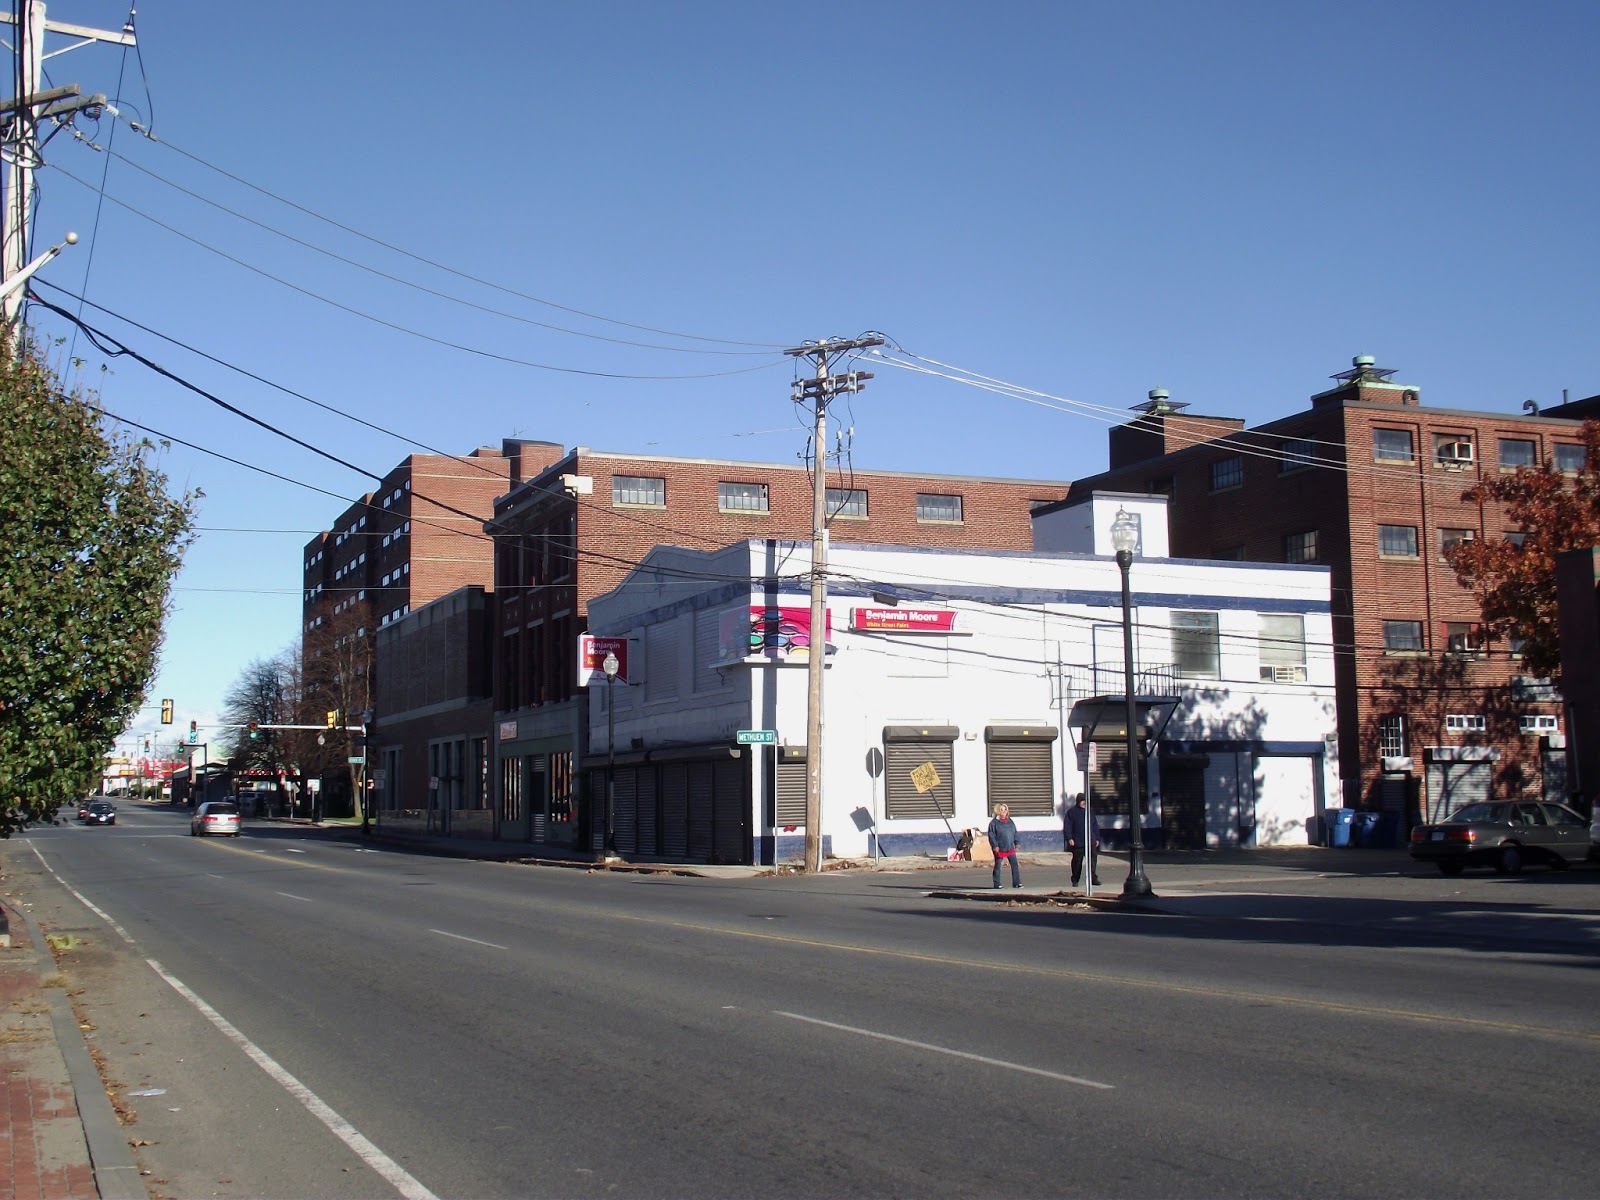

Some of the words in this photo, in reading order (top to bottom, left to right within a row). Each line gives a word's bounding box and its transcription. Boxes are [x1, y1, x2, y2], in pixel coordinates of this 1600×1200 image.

[865, 609, 908, 622] Benjamin
[909, 611, 939, 622] Moore
[587, 640, 620, 649] Benjamin
[739, 733, 765, 742] METHUEN
[766, 733, 773, 742] ST
